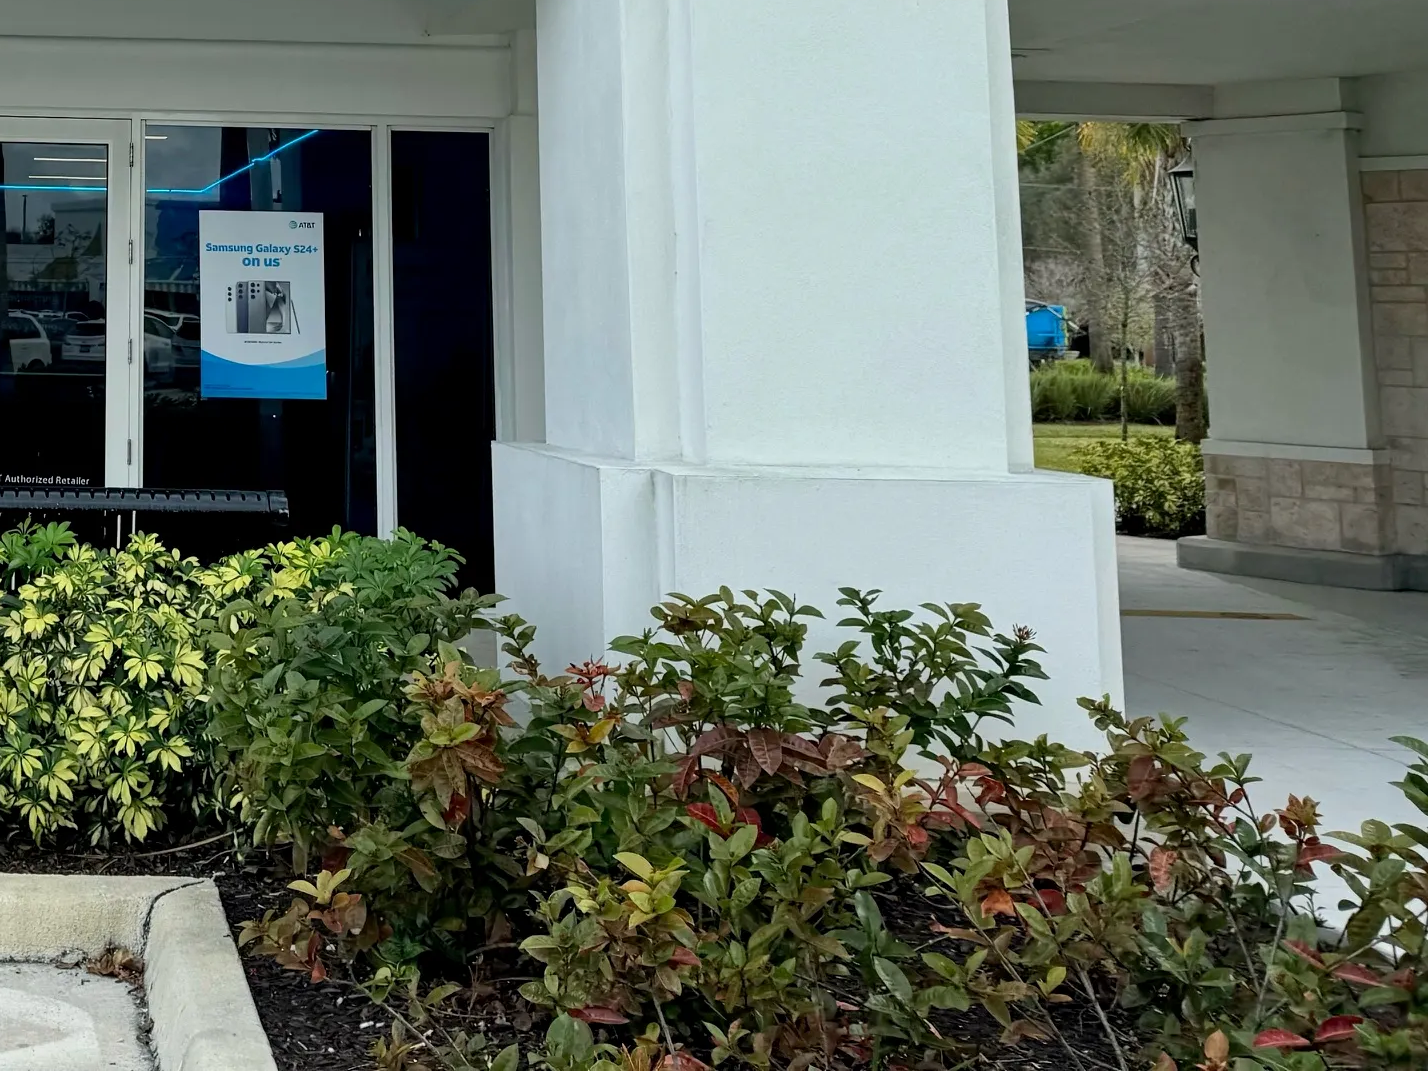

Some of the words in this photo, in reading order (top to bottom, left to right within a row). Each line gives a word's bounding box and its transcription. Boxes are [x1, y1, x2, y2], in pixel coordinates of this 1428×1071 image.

[206, 242, 253, 255] Samsung
[256, 243, 292, 255] Galaxy
[293, 245, 319, 254] S24+
[242, 257, 260, 267] on
[263, 257, 281, 267] us
[5, 475, 54, 484] Authorized
[56, 476, 90, 485] Retailer
